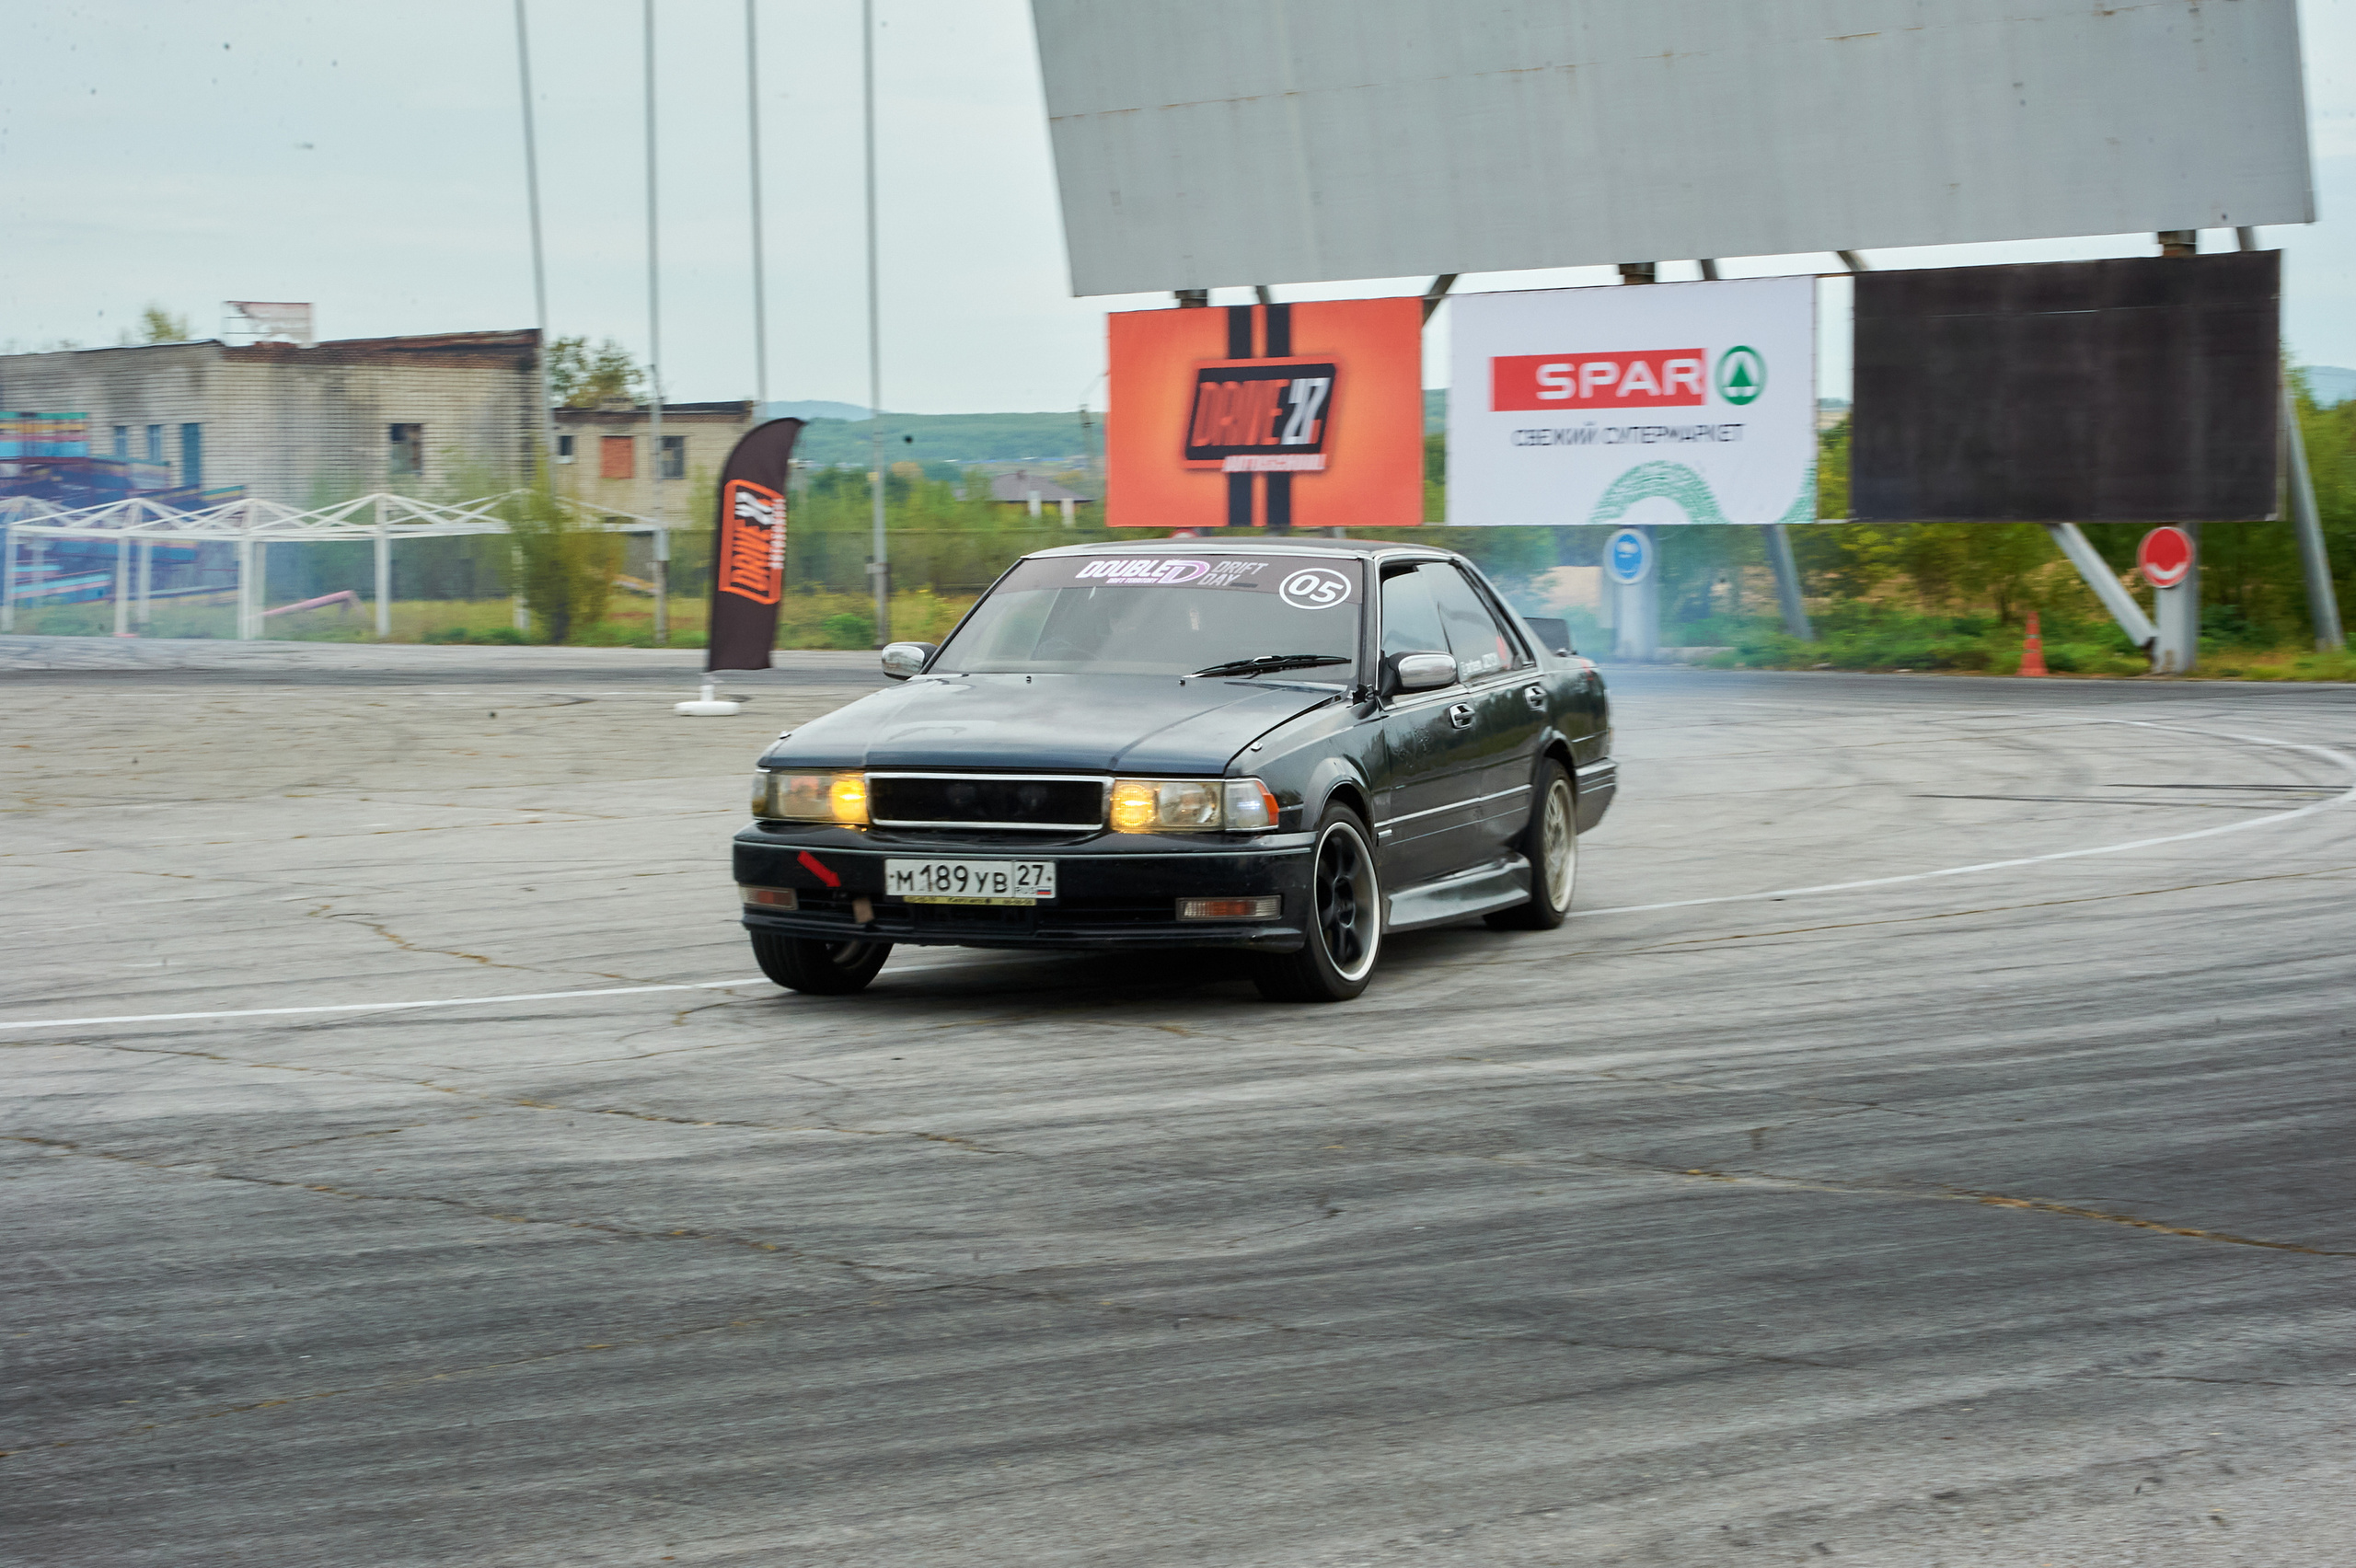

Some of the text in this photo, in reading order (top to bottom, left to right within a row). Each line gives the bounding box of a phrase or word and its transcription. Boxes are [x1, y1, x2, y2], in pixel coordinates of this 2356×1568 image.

[1536, 358, 1704, 400] SPAR
[1603, 423, 1745, 444] СУПЕРМАРКЕТ
[1211, 560, 1269, 574] DRIFT
[1197, 572, 1241, 586] DAY
[1288, 574, 1344, 603] 05
[1017, 864, 1044, 886] 27
